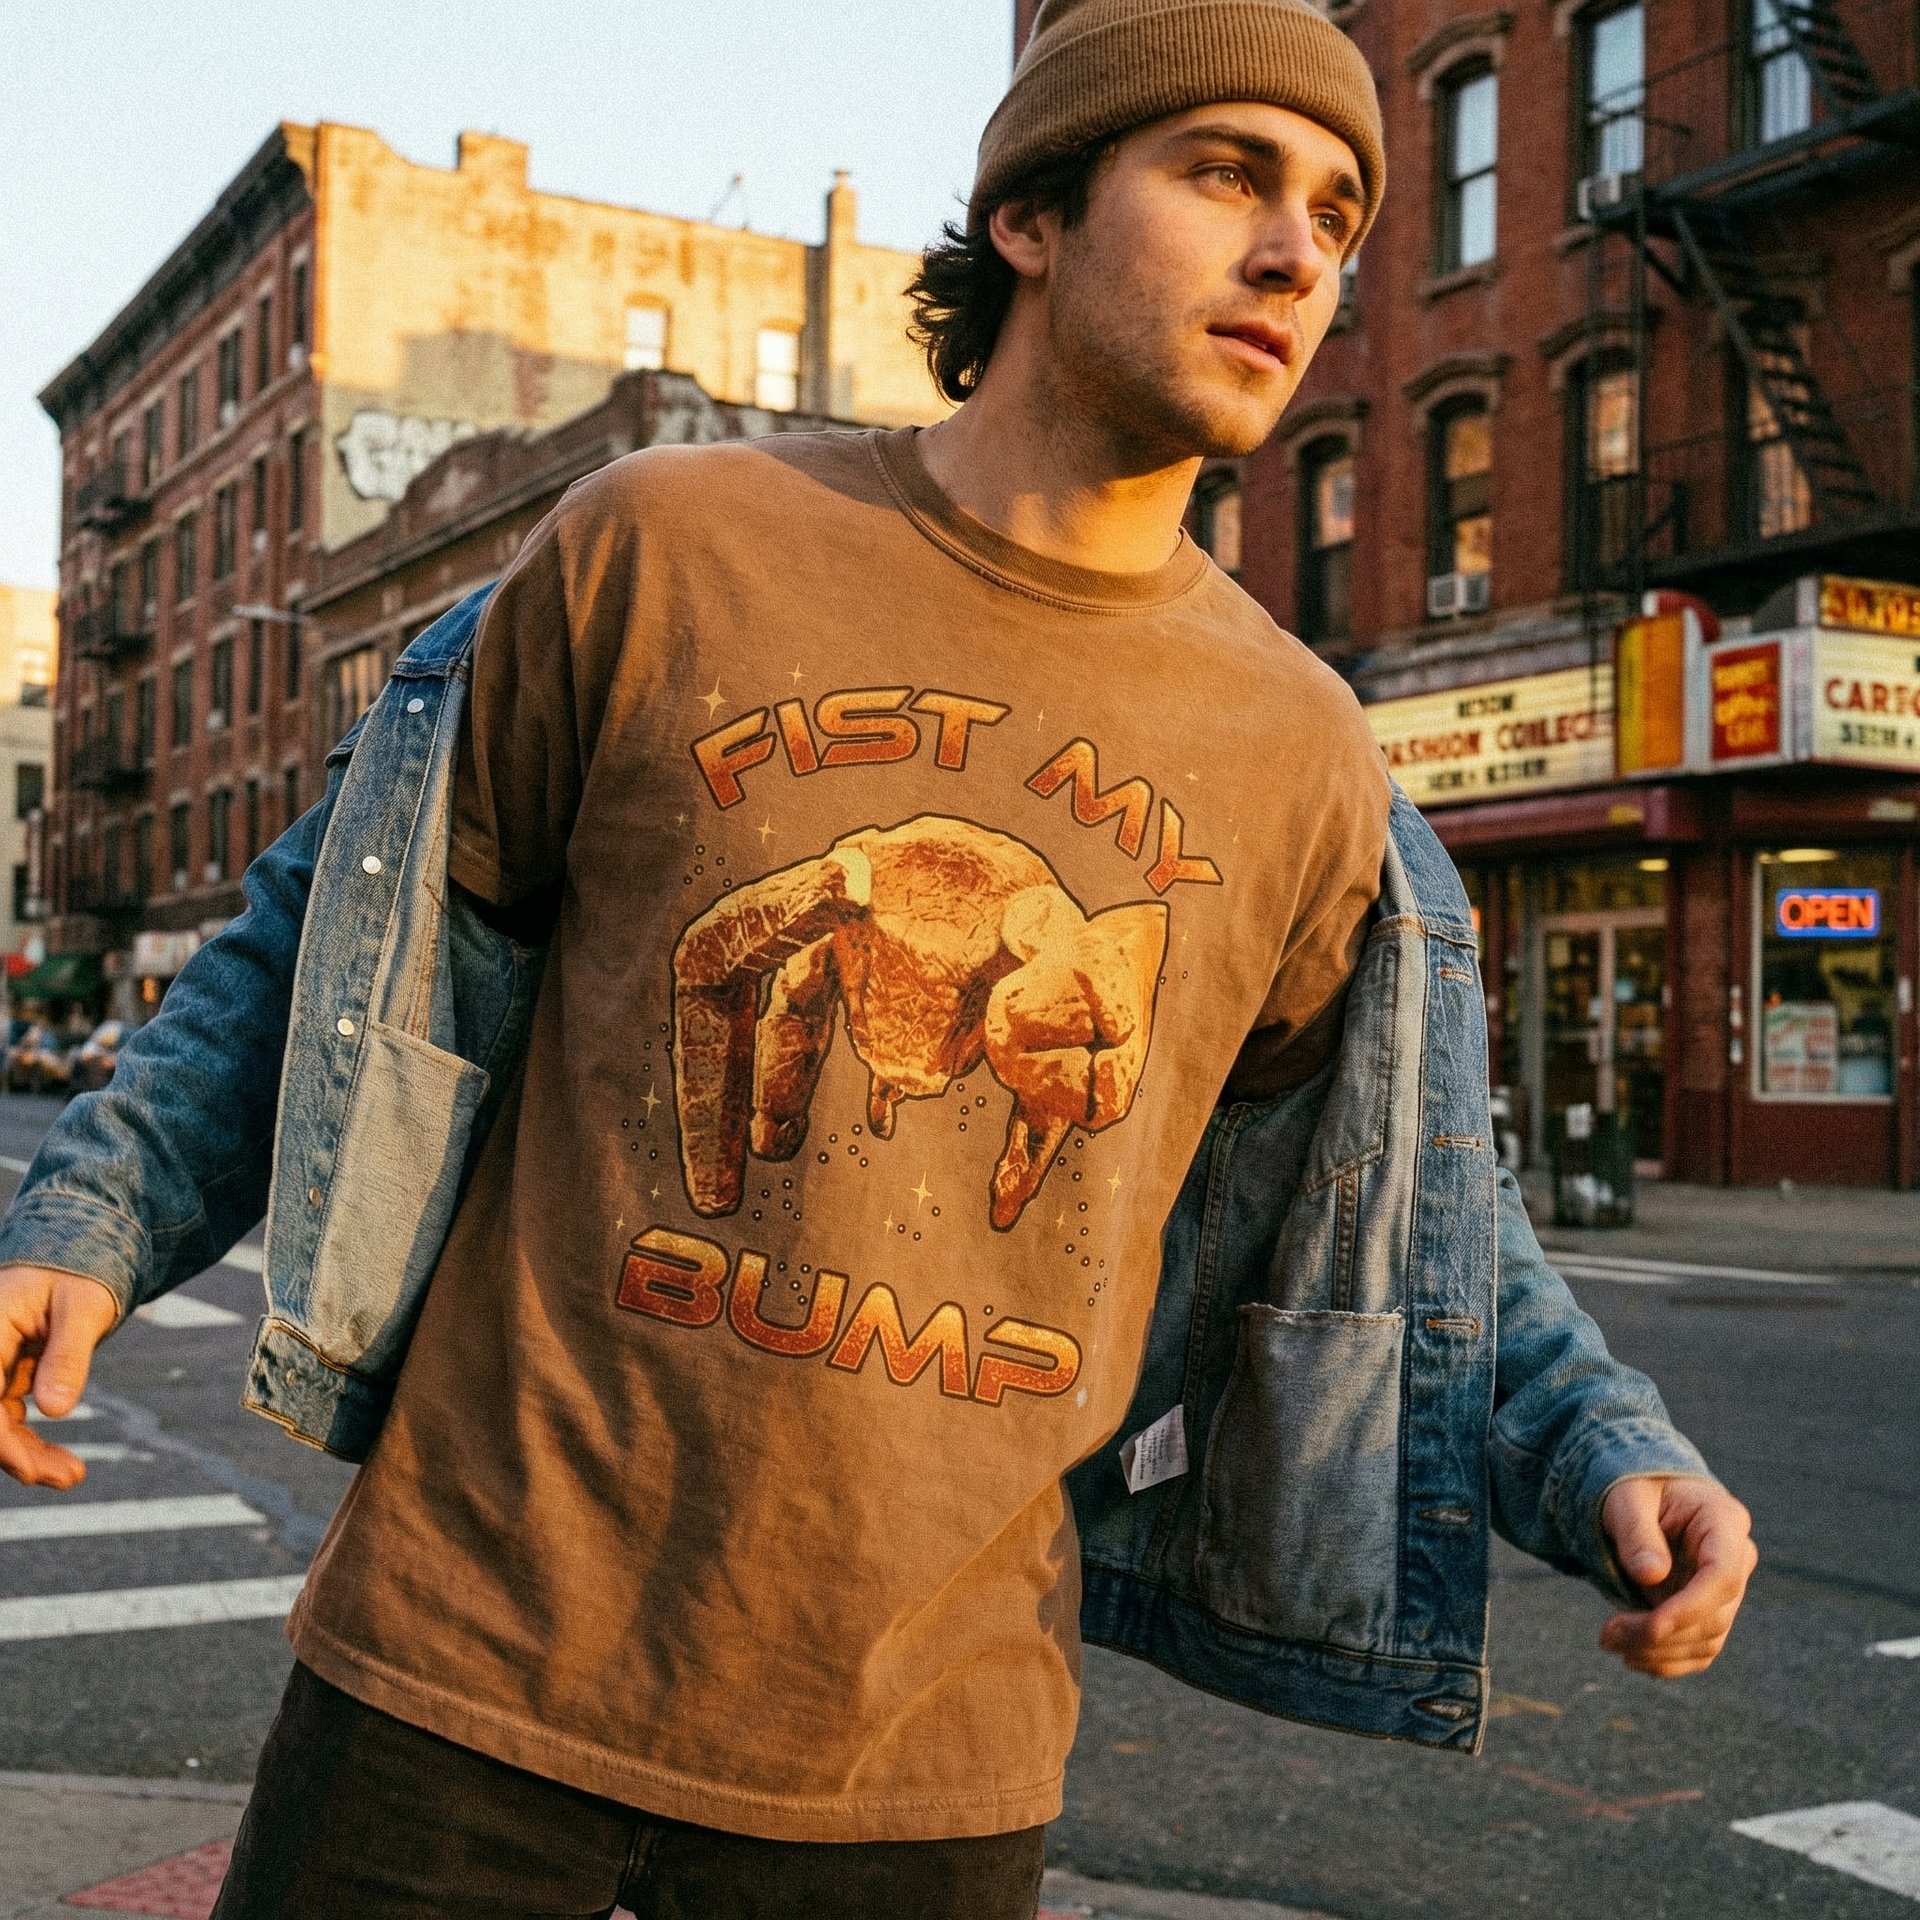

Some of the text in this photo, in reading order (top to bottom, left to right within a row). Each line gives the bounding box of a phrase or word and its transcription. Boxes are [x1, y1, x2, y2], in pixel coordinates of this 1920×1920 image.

[691, 685, 1224, 896] FIST MY
[1379, 729, 1480, 768] ASHION
[1780, 894, 1876, 931] OPEN
[615, 1224, 1082, 1407] BUMP
